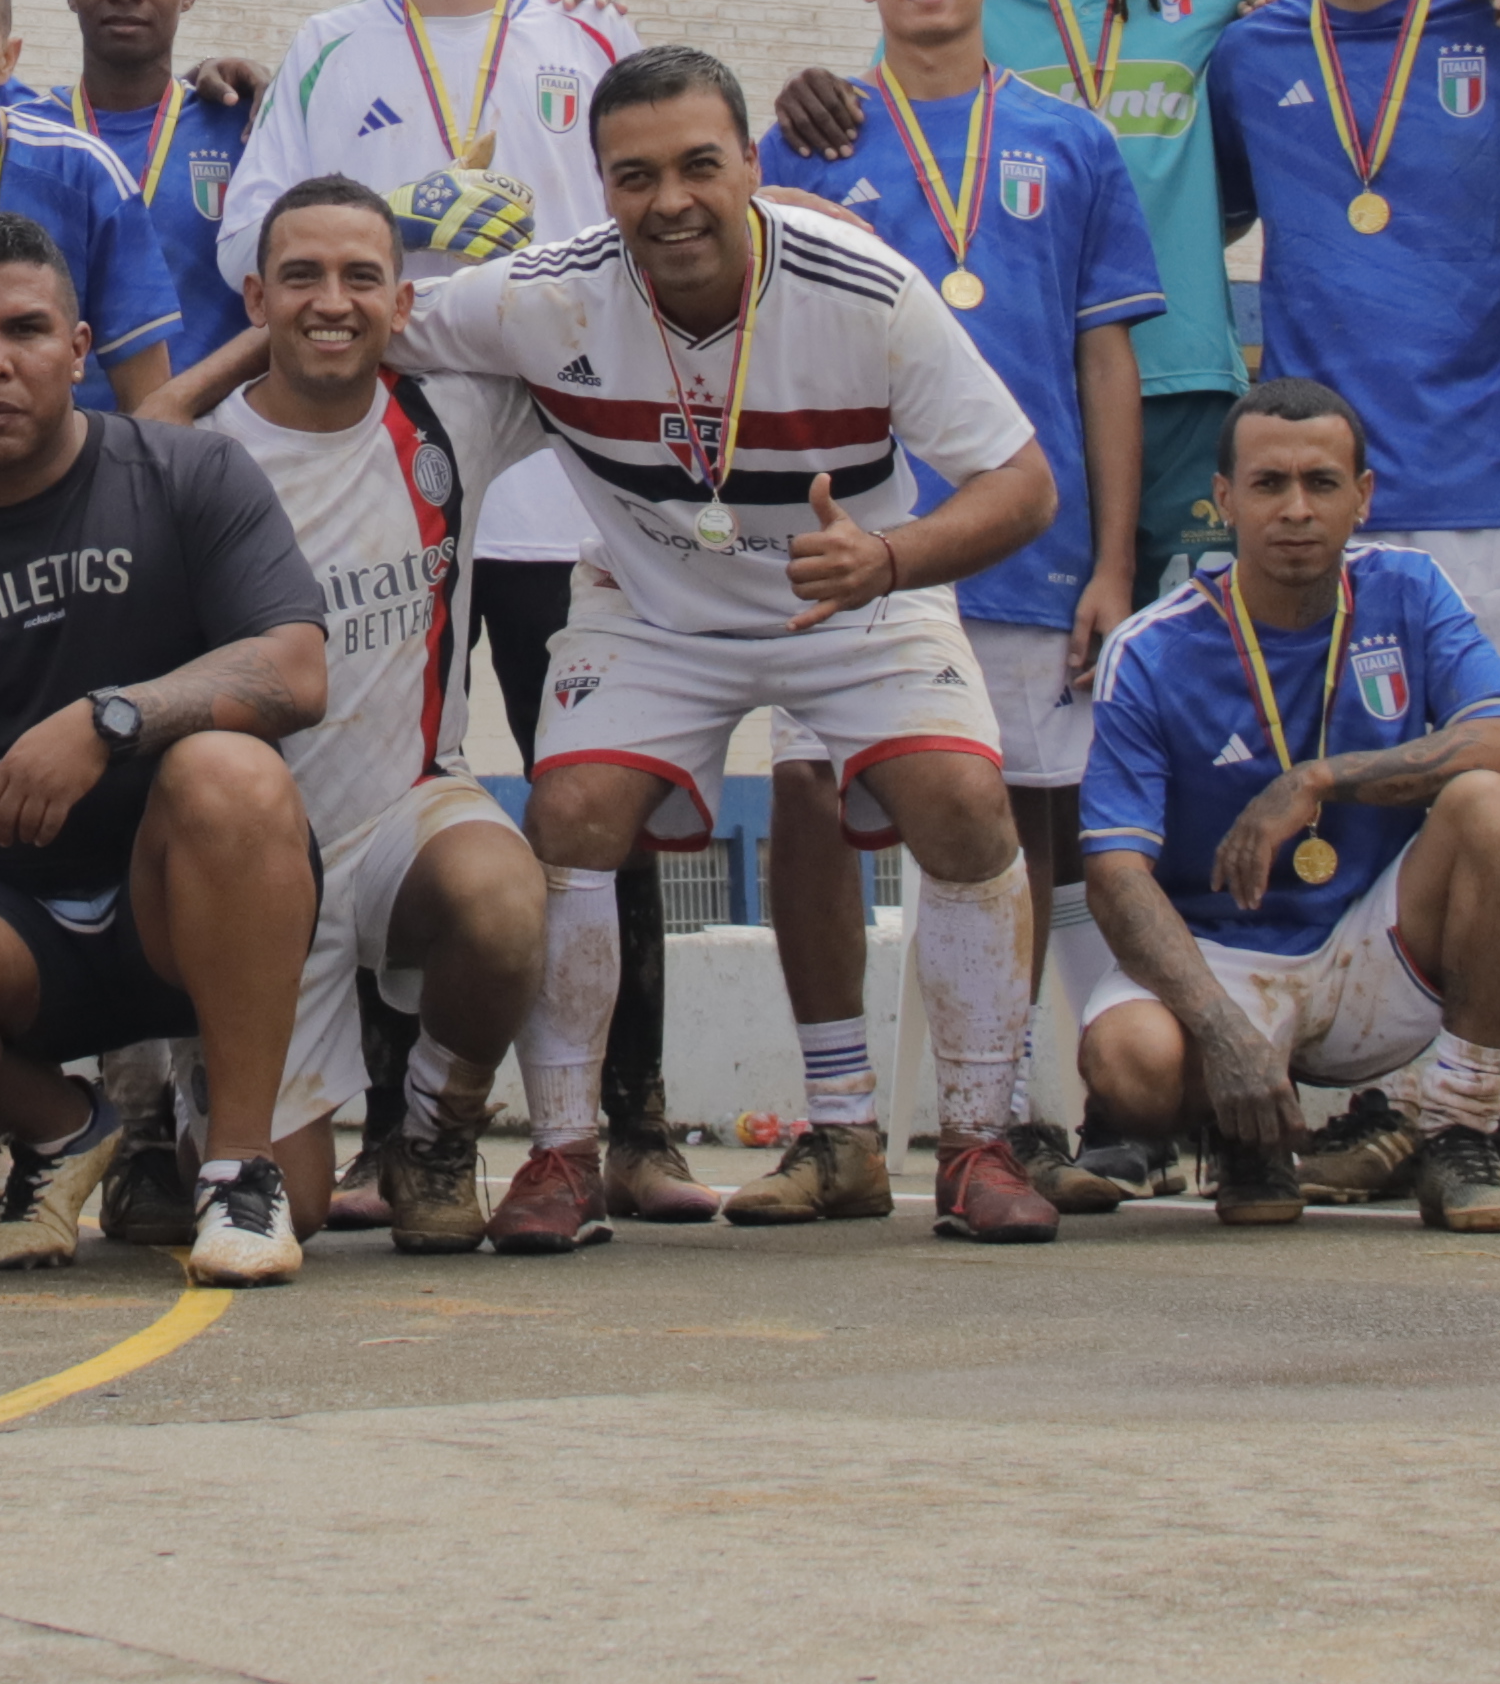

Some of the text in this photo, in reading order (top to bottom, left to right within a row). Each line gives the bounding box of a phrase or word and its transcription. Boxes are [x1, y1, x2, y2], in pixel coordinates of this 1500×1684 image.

[541, 78, 575, 90] ITALIA
[1004, 165, 1041, 179] ITALIA
[557, 369, 602, 387] adidas
[345, 593, 435, 655] BETTER
[1357, 653, 1399, 672] ITALIA
